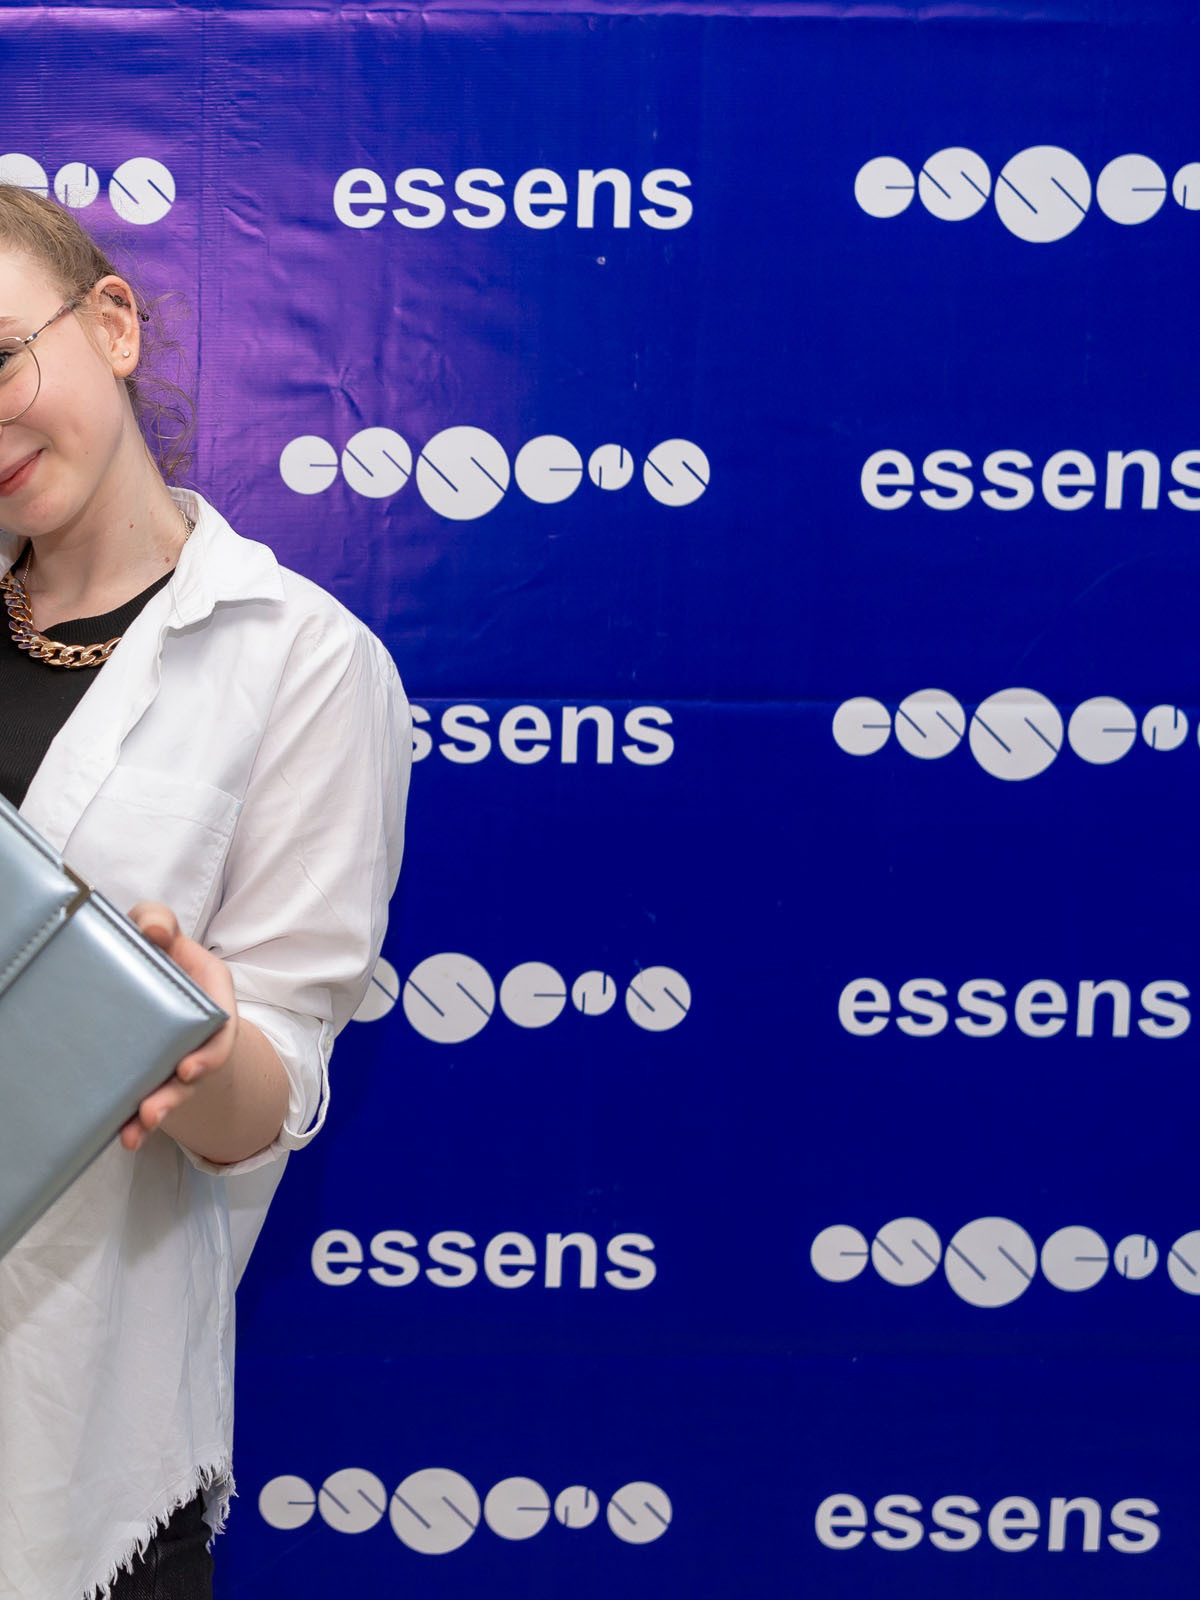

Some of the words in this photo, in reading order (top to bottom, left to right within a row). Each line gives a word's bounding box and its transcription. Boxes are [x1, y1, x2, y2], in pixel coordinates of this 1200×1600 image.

[332, 167, 694, 230] essens
[861, 449, 1200, 511] essens
[838, 978, 1192, 1039] essens
[311, 1229, 657, 1290] essens
[815, 1493, 1160, 1554] essens
